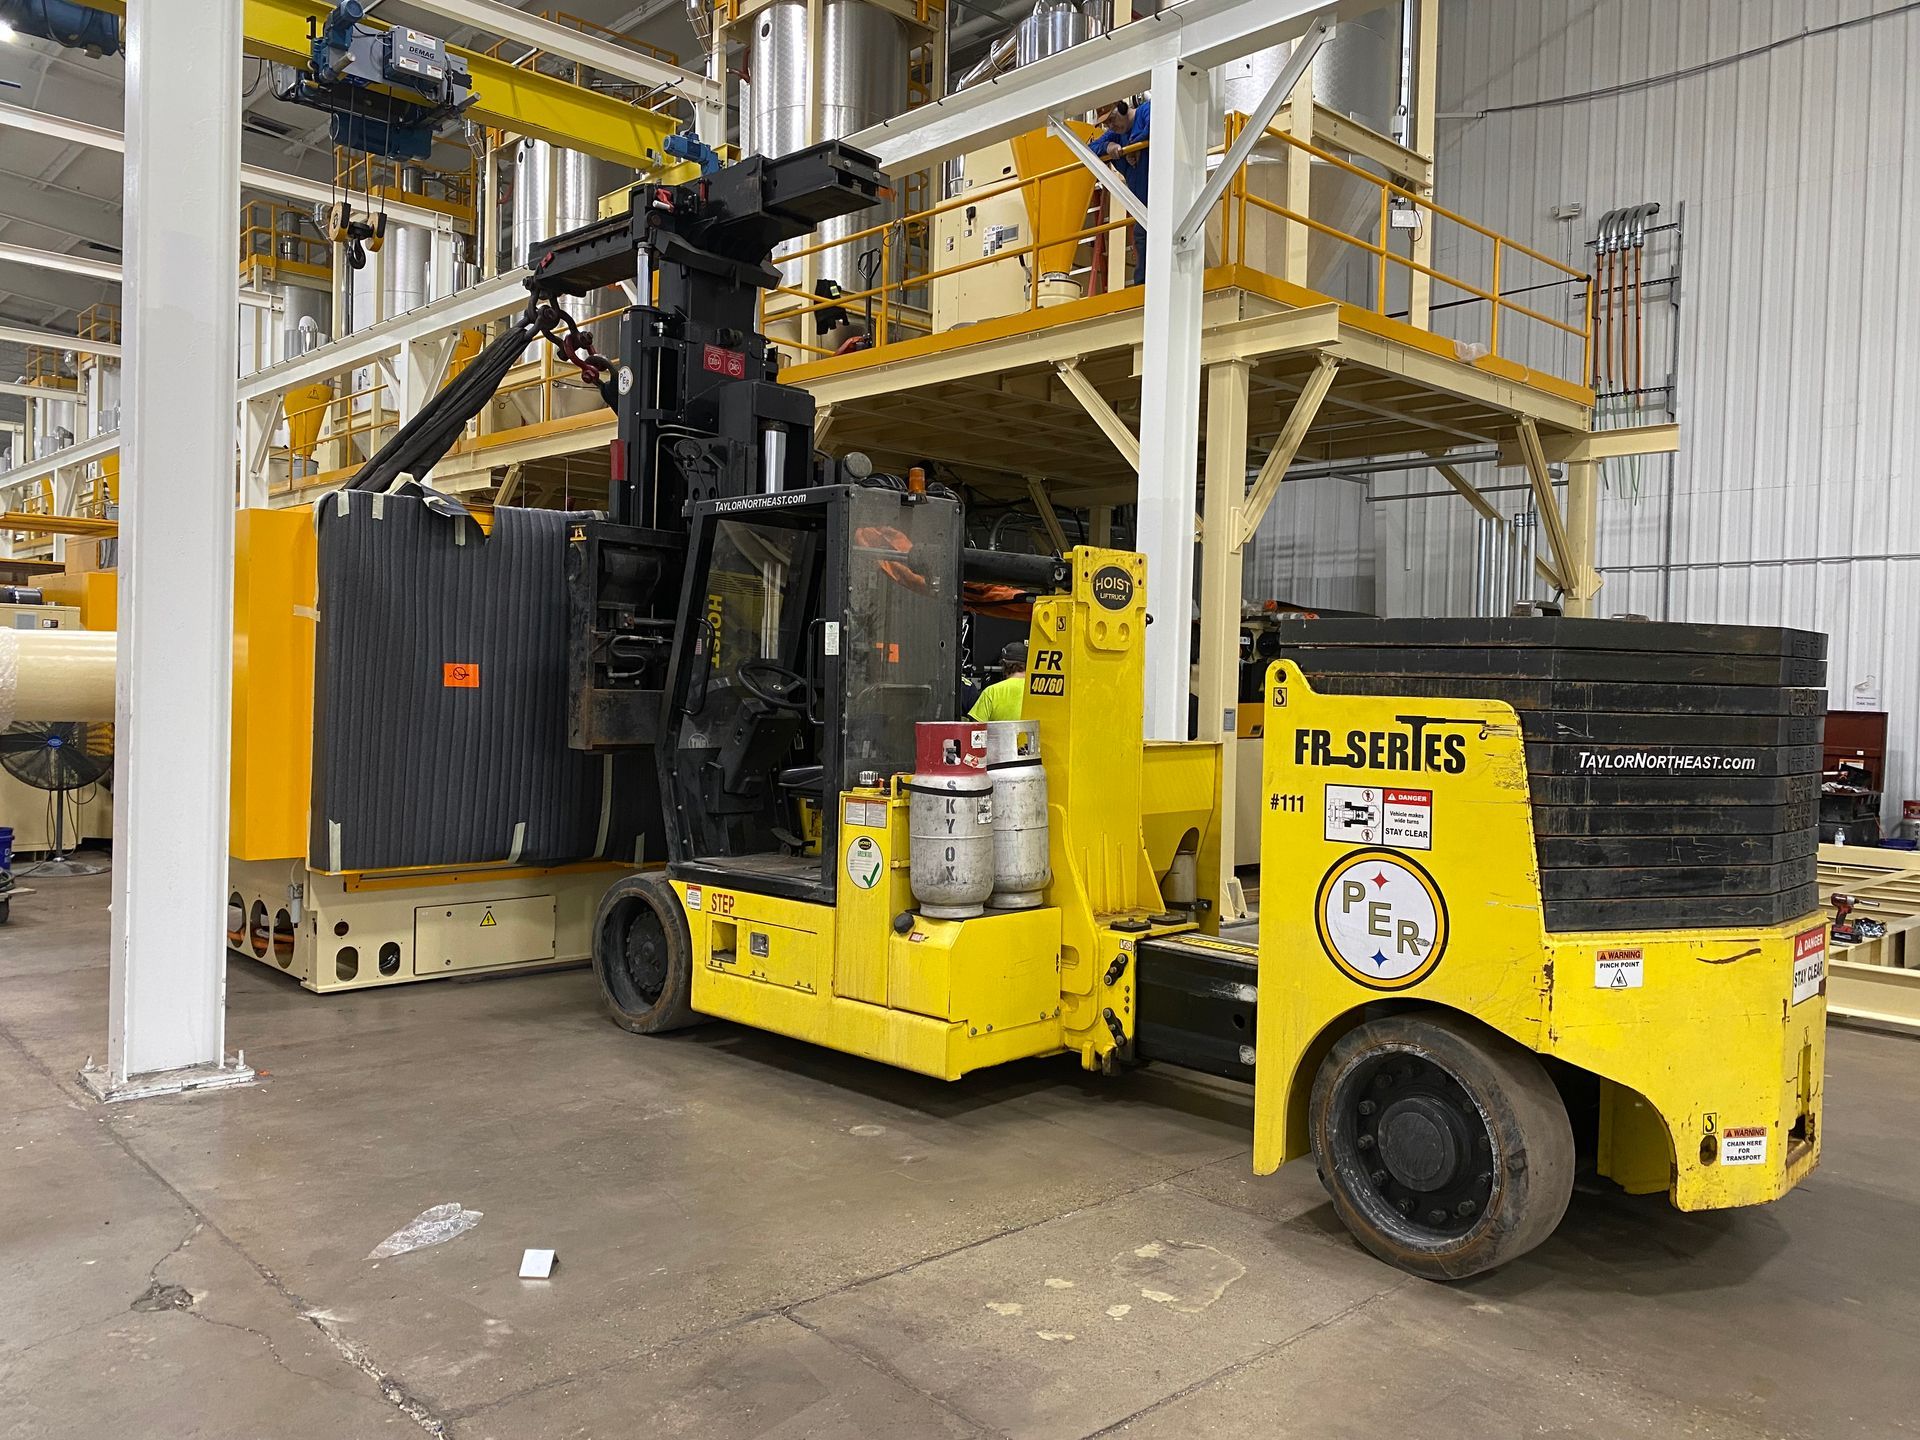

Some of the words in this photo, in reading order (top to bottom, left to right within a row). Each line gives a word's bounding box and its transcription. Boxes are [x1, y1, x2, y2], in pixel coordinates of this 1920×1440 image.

[409, 46, 435, 59] DEMAG
[1095, 577, 1131, 593] HOIST
[1100, 593, 1126, 601] LIFTRUCK
[1034, 650, 1063, 671] FR
[1031, 677, 1064, 694] 40/60
[1295, 729, 1331, 766] FR
[1270, 793, 1304, 813] #111
[1398, 794, 1427, 802] DANGER
[1390, 810, 1407, 818] Vehicle
[1385, 828, 1403, 836] STAY
[1404, 829, 1428, 839] CLEAR
[711, 893, 735, 914] STEP
[1342, 880, 1421, 956] PER
[1804, 933, 1824, 952] DANGER
[1608, 950, 1641, 960] WARNING
[1794, 968, 1807, 988] STAY
[1807, 961, 1823, 982] CLEAR
[1734, 1128, 1765, 1137] WARNING
[1726, 1154, 1762, 1162] TRANSPORT
